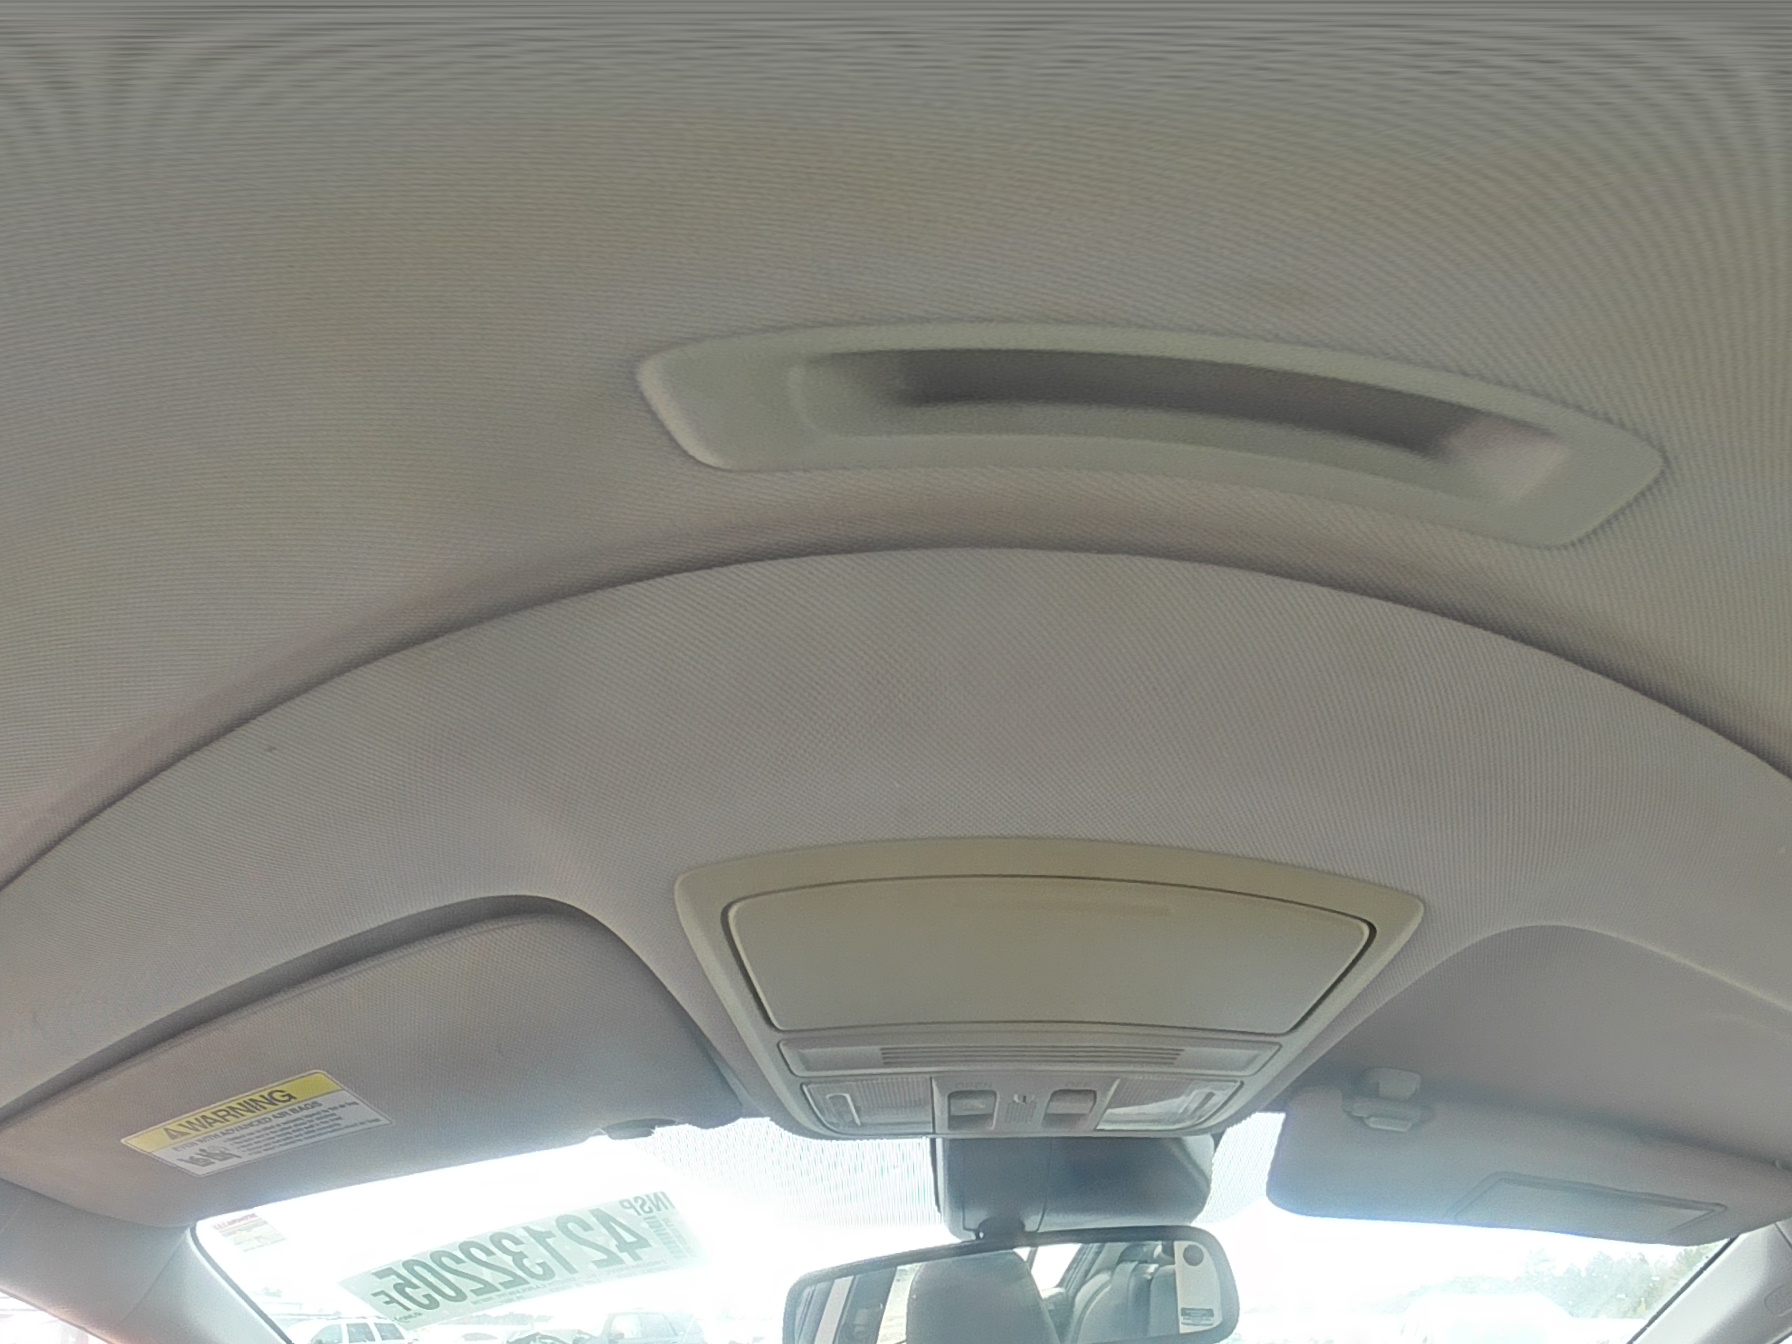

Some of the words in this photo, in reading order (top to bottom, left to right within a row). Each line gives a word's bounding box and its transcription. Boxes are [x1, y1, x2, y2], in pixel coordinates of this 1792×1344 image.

[182, 1089, 297, 1132] WARNING
[218, 1116, 273, 1138] ADVANCED
[291, 1100, 323, 1116] BAGS
